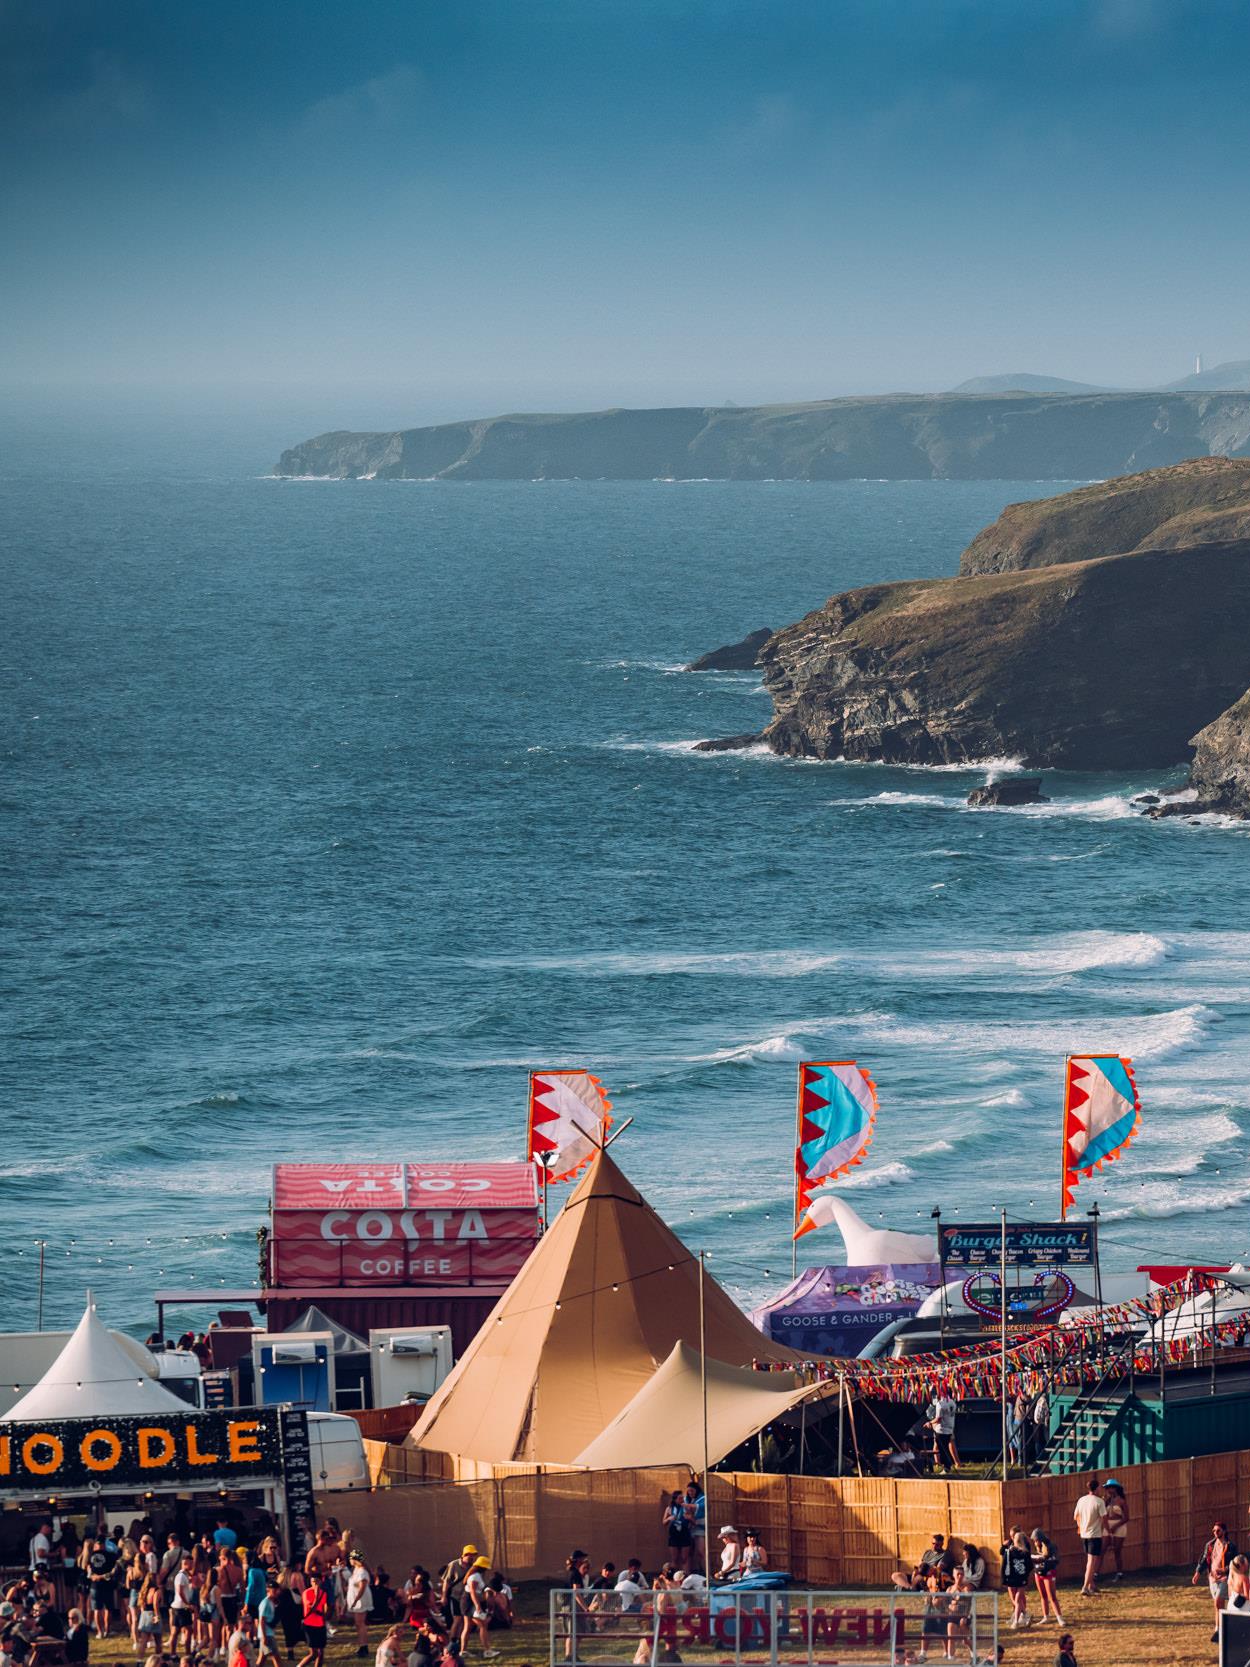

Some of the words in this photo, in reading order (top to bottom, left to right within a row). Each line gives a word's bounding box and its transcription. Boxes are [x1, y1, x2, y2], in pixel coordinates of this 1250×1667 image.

[319, 1179, 492, 1192] COSTA
[320, 1210, 490, 1251] COSTA
[948, 1233, 1014, 1249] Burger
[360, 1259, 452, 1275] COFFEE
[782, 1316, 826, 1327] GOOSE
[830, 1315, 838, 1325] &
[842, 1312, 893, 1324] GANDER
[0, 1421, 262, 1475] OODLE
